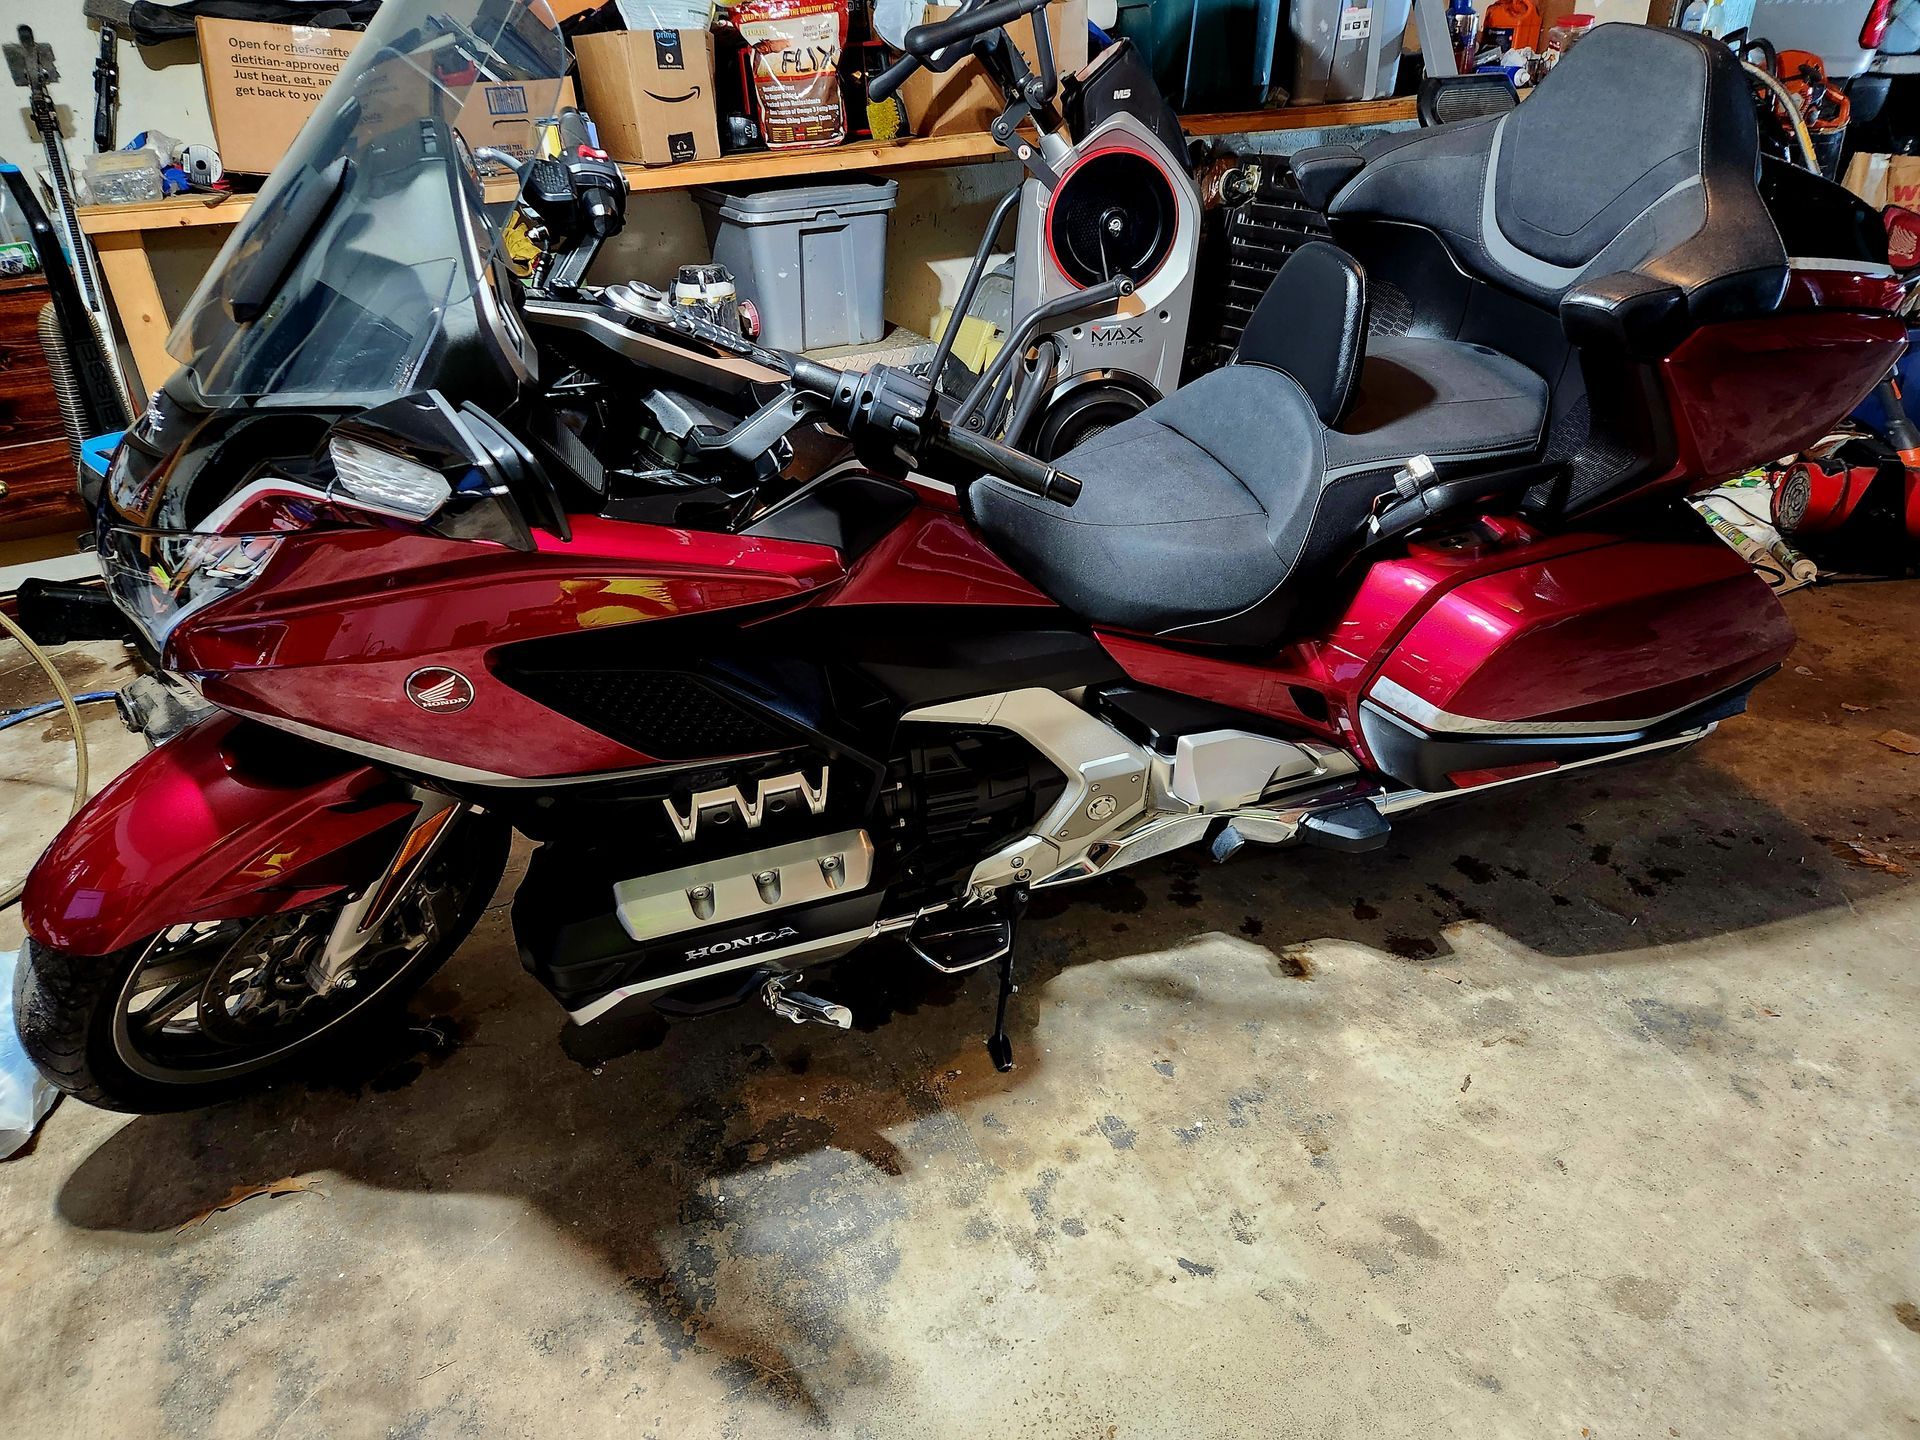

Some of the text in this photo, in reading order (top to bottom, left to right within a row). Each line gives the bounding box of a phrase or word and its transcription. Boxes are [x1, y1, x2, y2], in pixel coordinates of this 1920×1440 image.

[655, 32, 677, 40] prime
[228, 37, 353, 58] Open for chef-crafte
[231, 54, 340, 72] dietitian-approved
[233, 69, 259, 81] Just
[261, 71, 291, 84] heat,
[294, 75, 316, 86] eat,
[235, 86, 254, 97] get
[257, 87, 286, 99] back
[288, 89, 300, 99] to
[1113, 88, 1131, 100] M5
[1091, 326, 1143, 343] MAX
[1091, 339, 1144, 348] TRAINER
[421, 697, 468, 708] HONDA
[684, 926, 799, 962] HONDA
